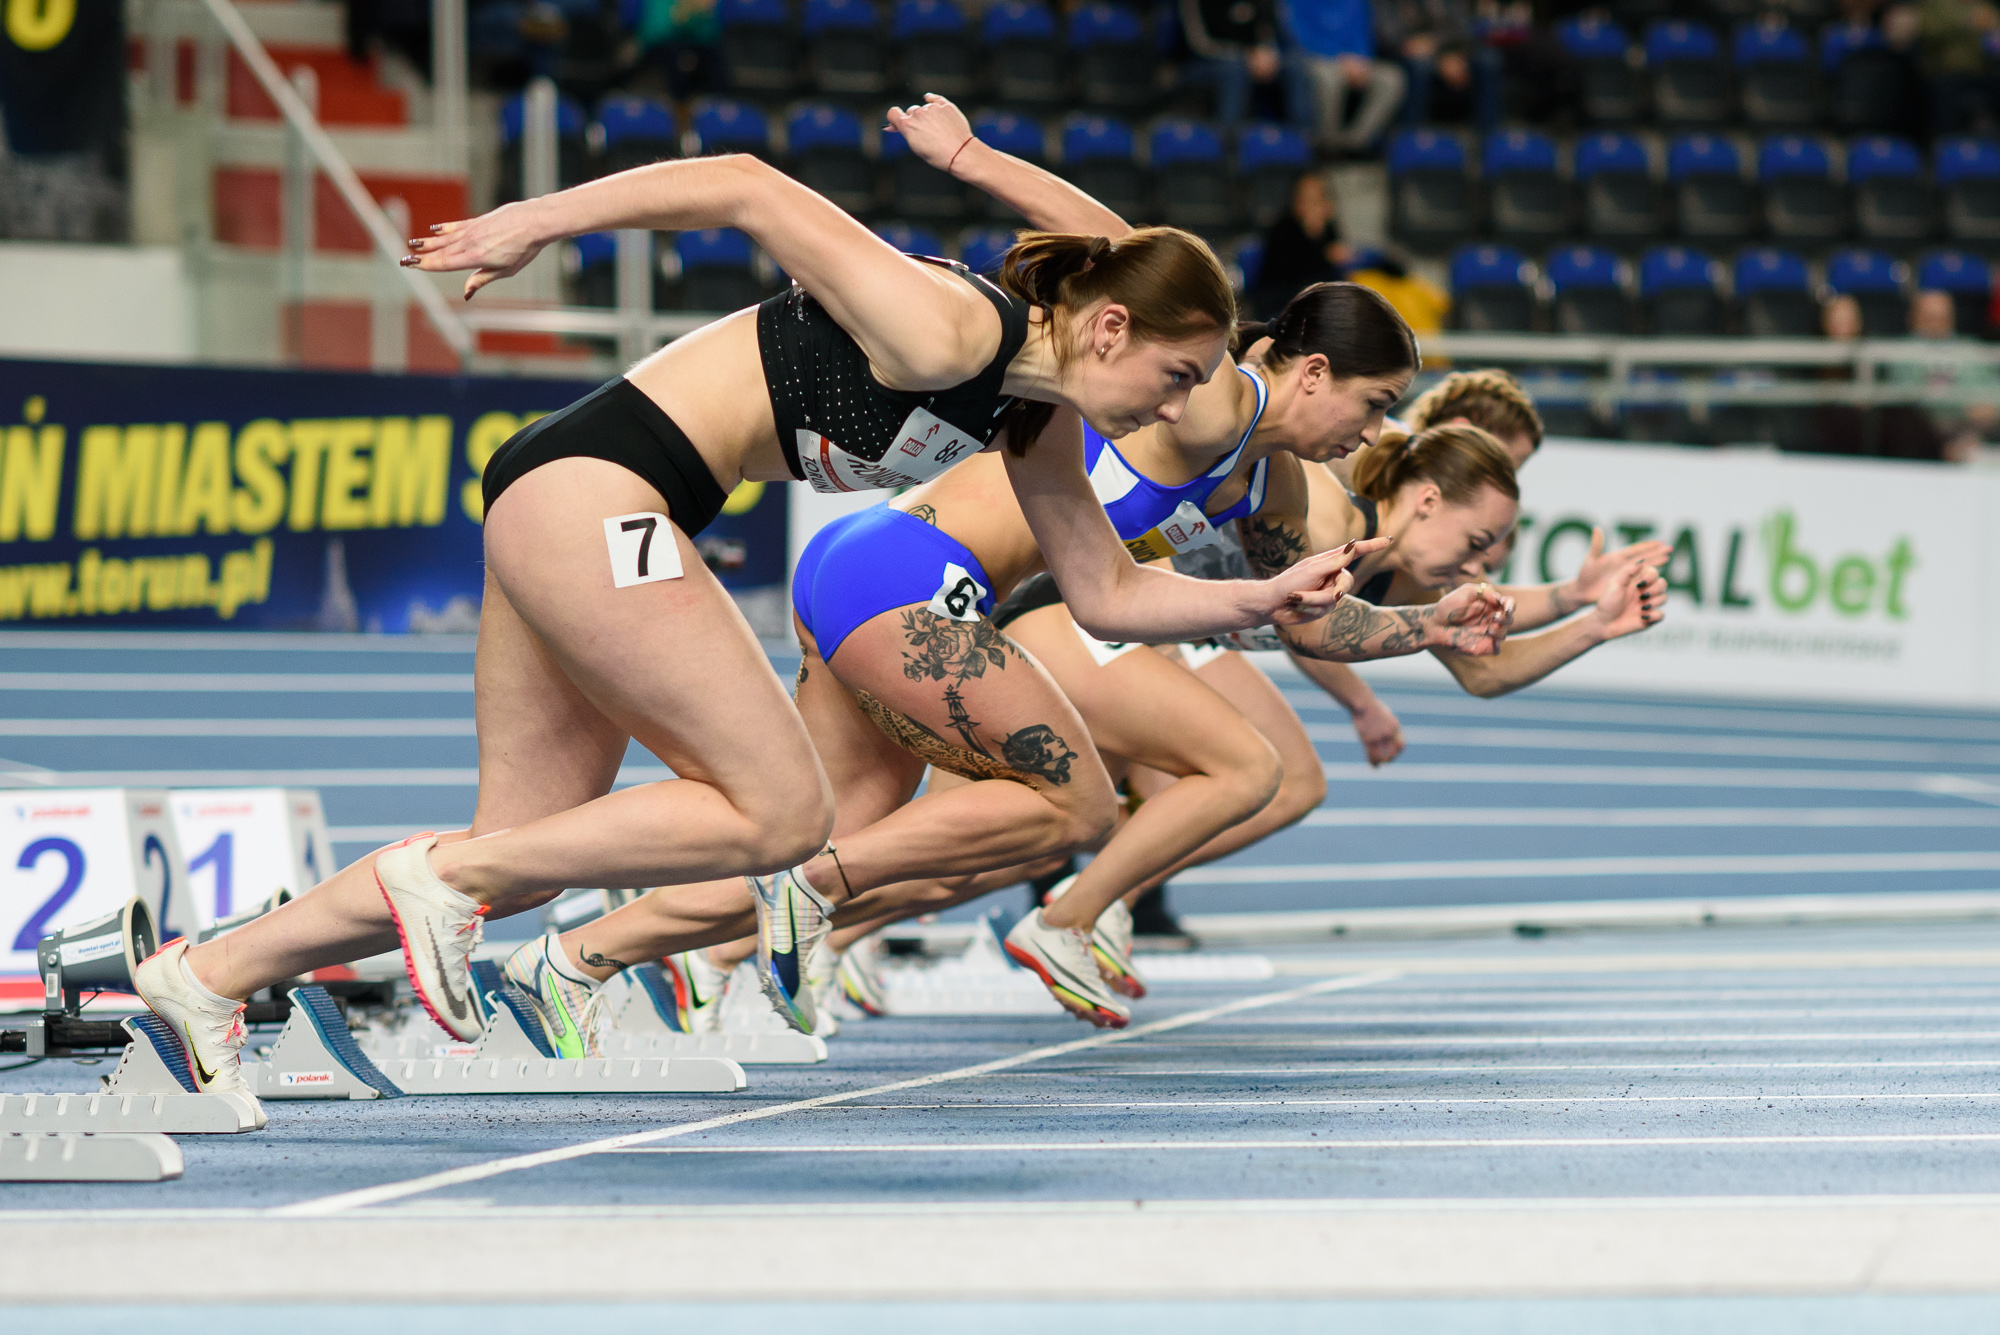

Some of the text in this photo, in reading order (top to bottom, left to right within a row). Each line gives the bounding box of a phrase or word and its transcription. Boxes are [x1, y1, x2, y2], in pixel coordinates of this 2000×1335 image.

[76, 416, 453, 541] MIASTEM
[934, 439, 966, 464] 86
[621, 517, 657, 578] 7
[945, 577, 977, 617] 6
[11, 836, 87, 952] 2
[143, 834, 182, 944] 2
[187, 831, 233, 918] 1
[296, 1074, 329, 1084] polanik
